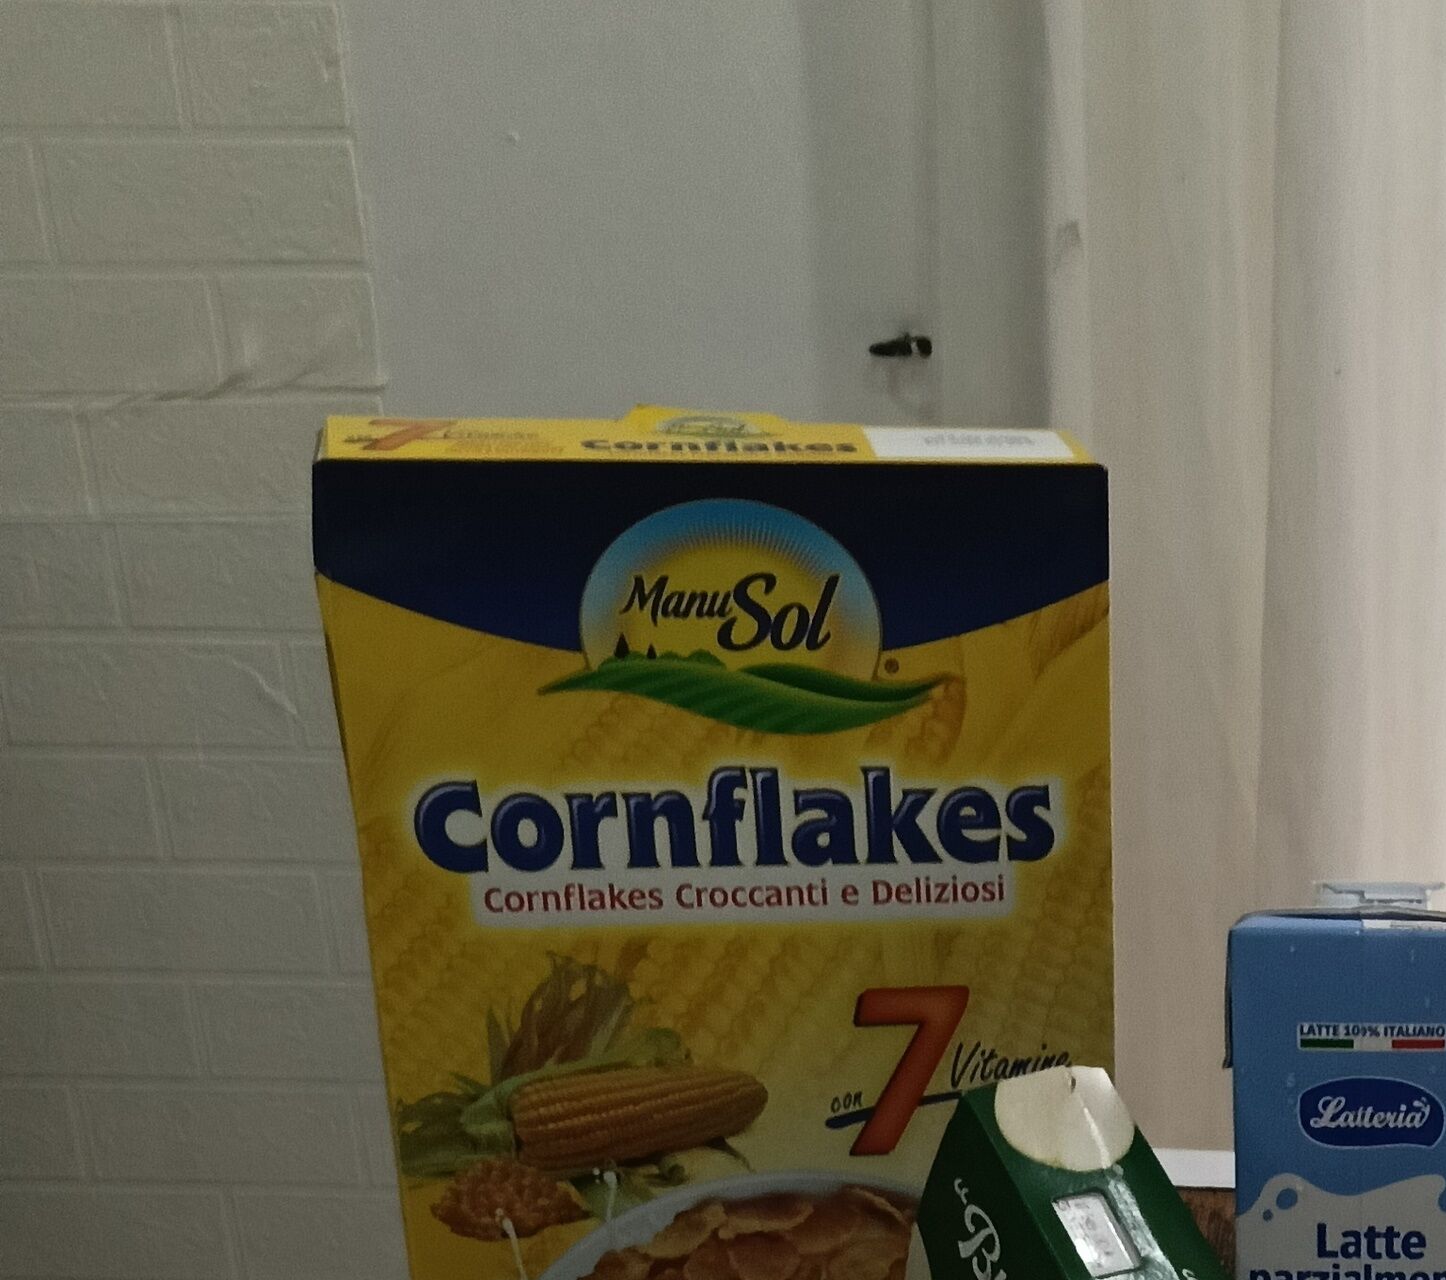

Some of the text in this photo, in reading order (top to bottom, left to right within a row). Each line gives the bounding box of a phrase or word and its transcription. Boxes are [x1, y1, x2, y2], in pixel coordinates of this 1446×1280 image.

[580, 437, 858, 454] Cornflakes
[414, 765, 1056, 874] Cornflakes
[483, 875, 1006, 914] Cornflakes Croccanti e Deliziosi
[1300, 1023, 1446, 1038] LATTE 100% ITALIANO
[849, 985, 970, 1157] 7
[1309, 1095, 1431, 1131] Latteria
[1317, 1222, 1427, 1261] Latte
